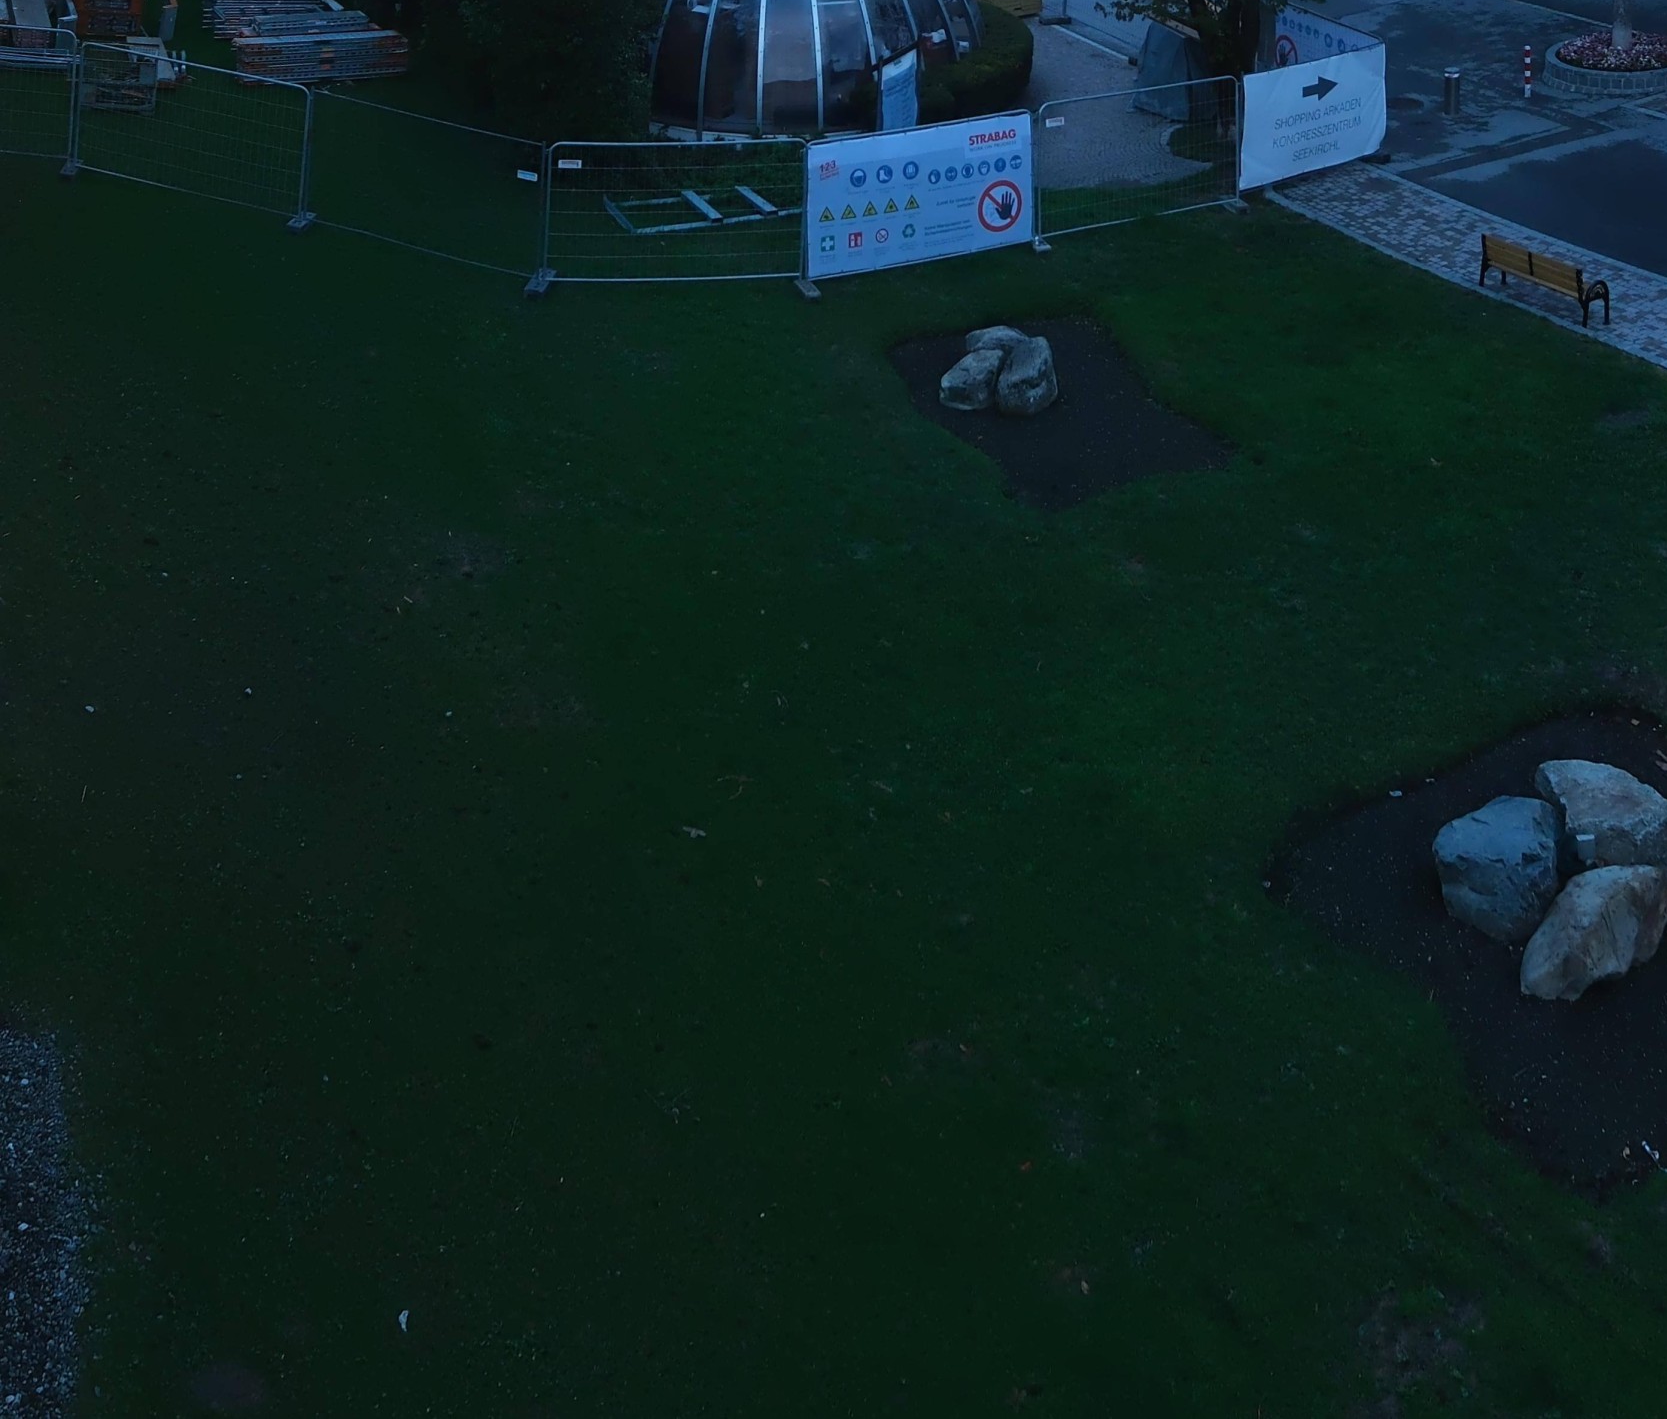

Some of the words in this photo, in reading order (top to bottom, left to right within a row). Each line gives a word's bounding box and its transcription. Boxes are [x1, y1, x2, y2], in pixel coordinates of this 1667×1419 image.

[1274, 109, 1321, 130] SHOPPING
[1323, 97, 1362, 116] ARKADEN
[969, 129, 1017, 146] STRABAG
[1272, 116, 1362, 149] KONGRESSZENTRUM
[1292, 142, 1341, 162] SEEKIRCHL
